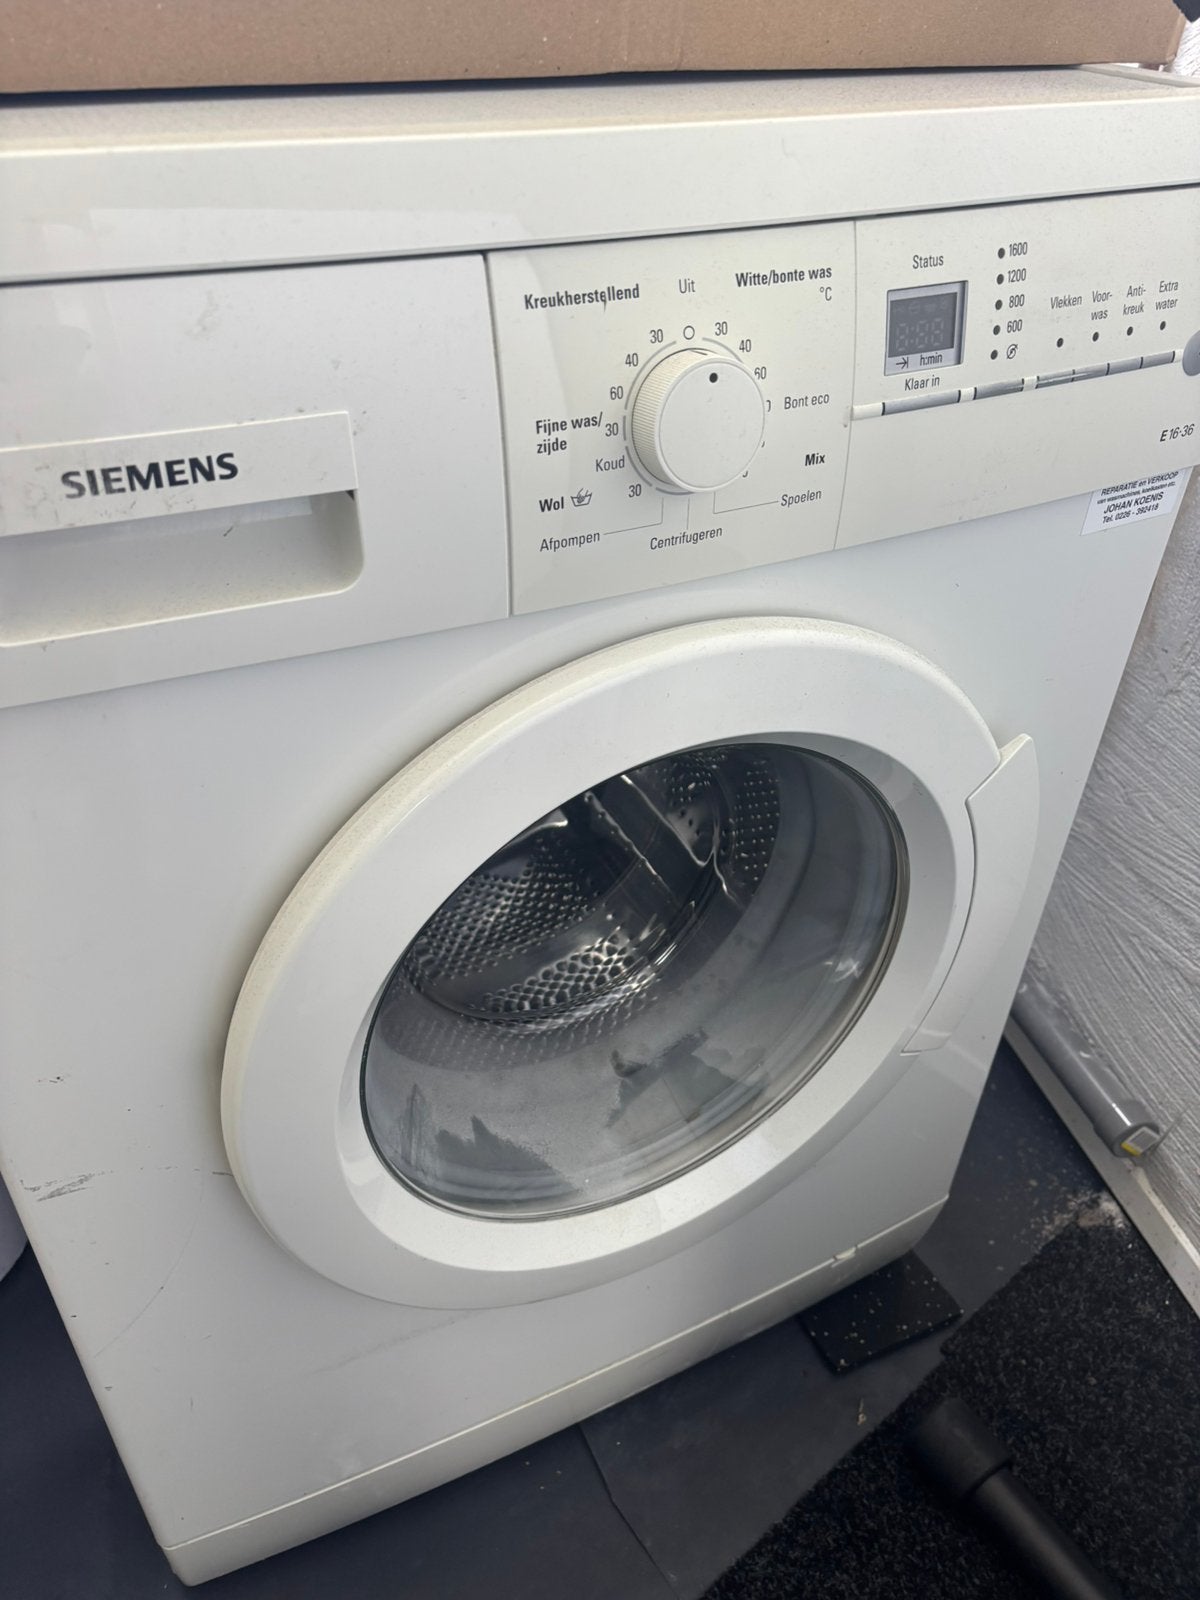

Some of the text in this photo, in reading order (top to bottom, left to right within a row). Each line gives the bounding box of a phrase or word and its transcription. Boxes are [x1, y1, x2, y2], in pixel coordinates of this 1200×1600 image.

[1008, 241, 1028, 257] 1600
[912, 254, 944, 270] Status
[735, 267, 833, 288] Witte/bonte was
[1007, 268, 1027, 284] 1200
[678, 278, 696, 294] Uit
[1126, 283, 1147, 298] Anti-
[1158, 280, 1179, 293] Extra
[524, 283, 640, 310] Kreukherstellend
[1008, 294, 1025, 309] 800
[1050, 295, 1083, 310] Vlekken
[1092, 290, 1113, 303] Voor-
[1155, 298, 1178, 311] water
[1090, 309, 1109, 321] was
[1122, 301, 1145, 316] kreuk
[714, 321, 728, 337] 30
[1006, 319, 1023, 334] 600
[649, 328, 664, 344] 30
[738, 338, 752, 354] 40
[624, 352, 639, 368] 40
[919, 351, 943, 366] h:min
[754, 366, 767, 380] 60
[904, 375, 940, 392] Klaar in
[609, 384, 624, 401] 60
[783, 395, 809, 411] Bont
[811, 392, 830, 407] eco
[535, 411, 604, 436] Fijne was/
[605, 422, 619, 437] 30
[1160, 429, 1168, 442] E
[536, 437, 568, 455] zijde
[595, 455, 625, 473] Koud
[804, 453, 826, 468] Mix
[60, 452, 239, 499] SIEMENS
[627, 483, 643, 499] 30
[1101, 471, 1179, 497] REPARATIE en VERKOOP
[538, 496, 565, 513] Wol
[780, 489, 823, 509] Spoelen
[1104, 491, 1164, 514] JOHAN KOENIS
[1114, 510, 1131, 521] 0226
[538, 531, 601, 552] Afpompen
[649, 526, 723, 551] Centrifugeren
